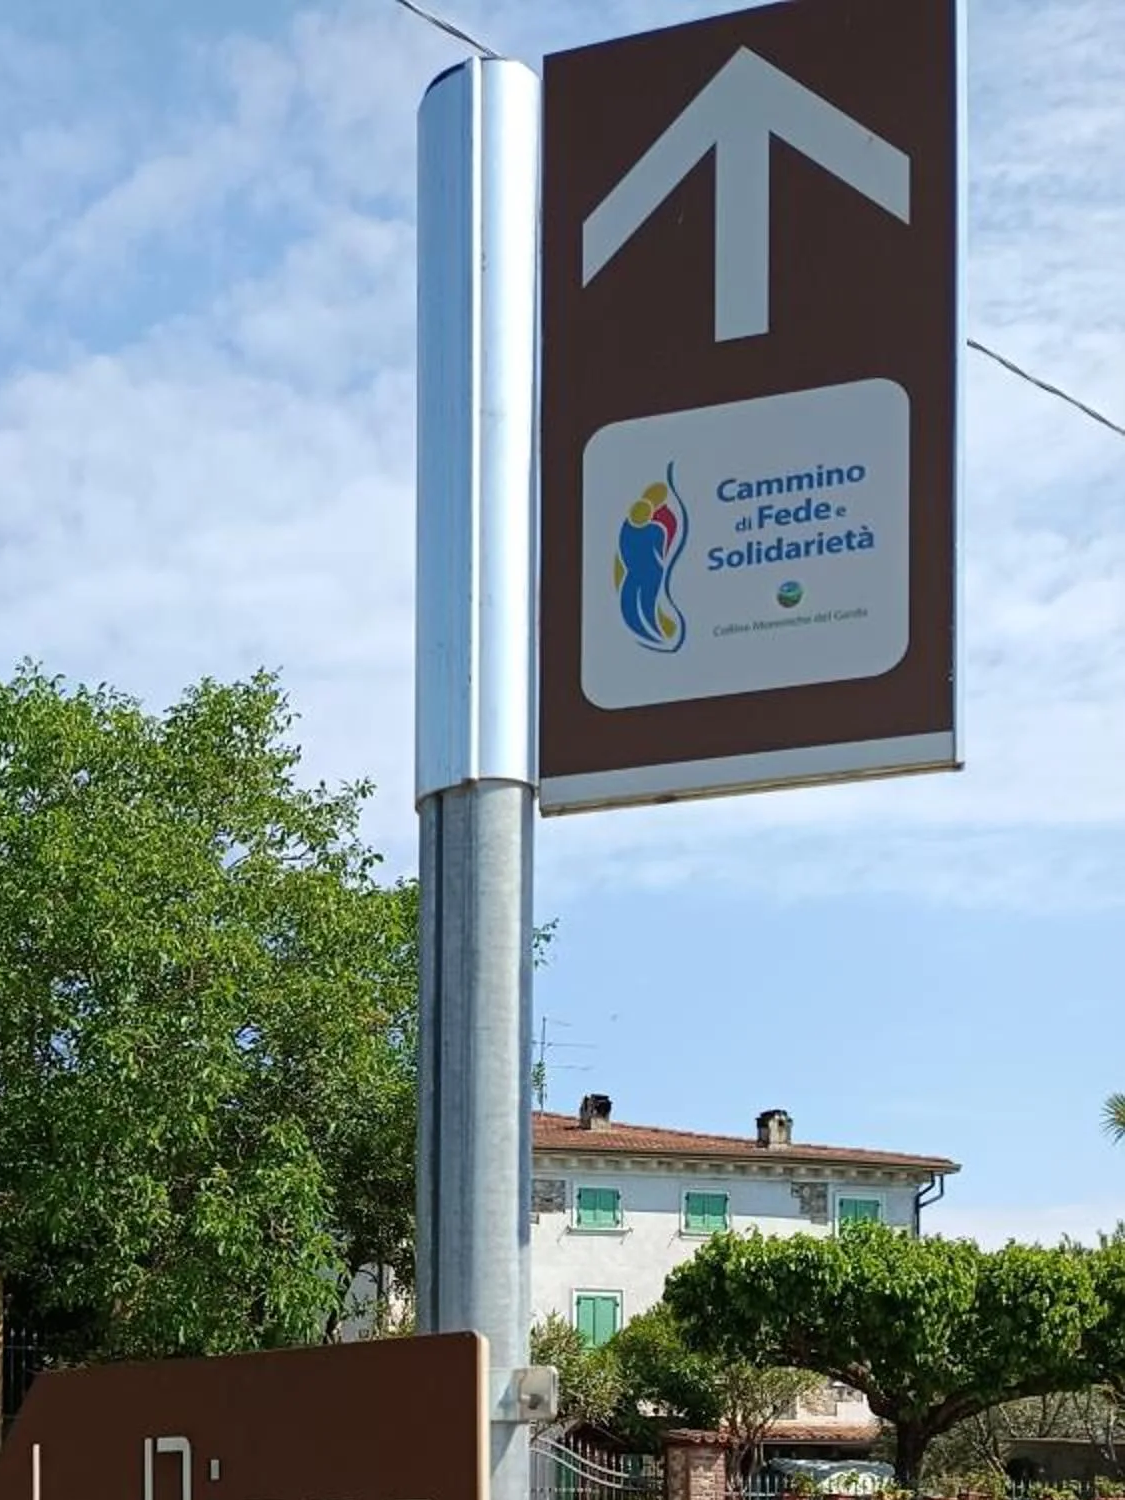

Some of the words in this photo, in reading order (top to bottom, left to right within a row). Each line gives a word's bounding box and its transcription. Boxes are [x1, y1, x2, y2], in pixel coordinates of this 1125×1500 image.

[716, 463, 866, 503] Cammino
[735, 516, 752, 533] di
[757, 498, 831, 529] Fede
[835, 505, 847, 518] e
[708, 525, 875, 571] Solidarietà
